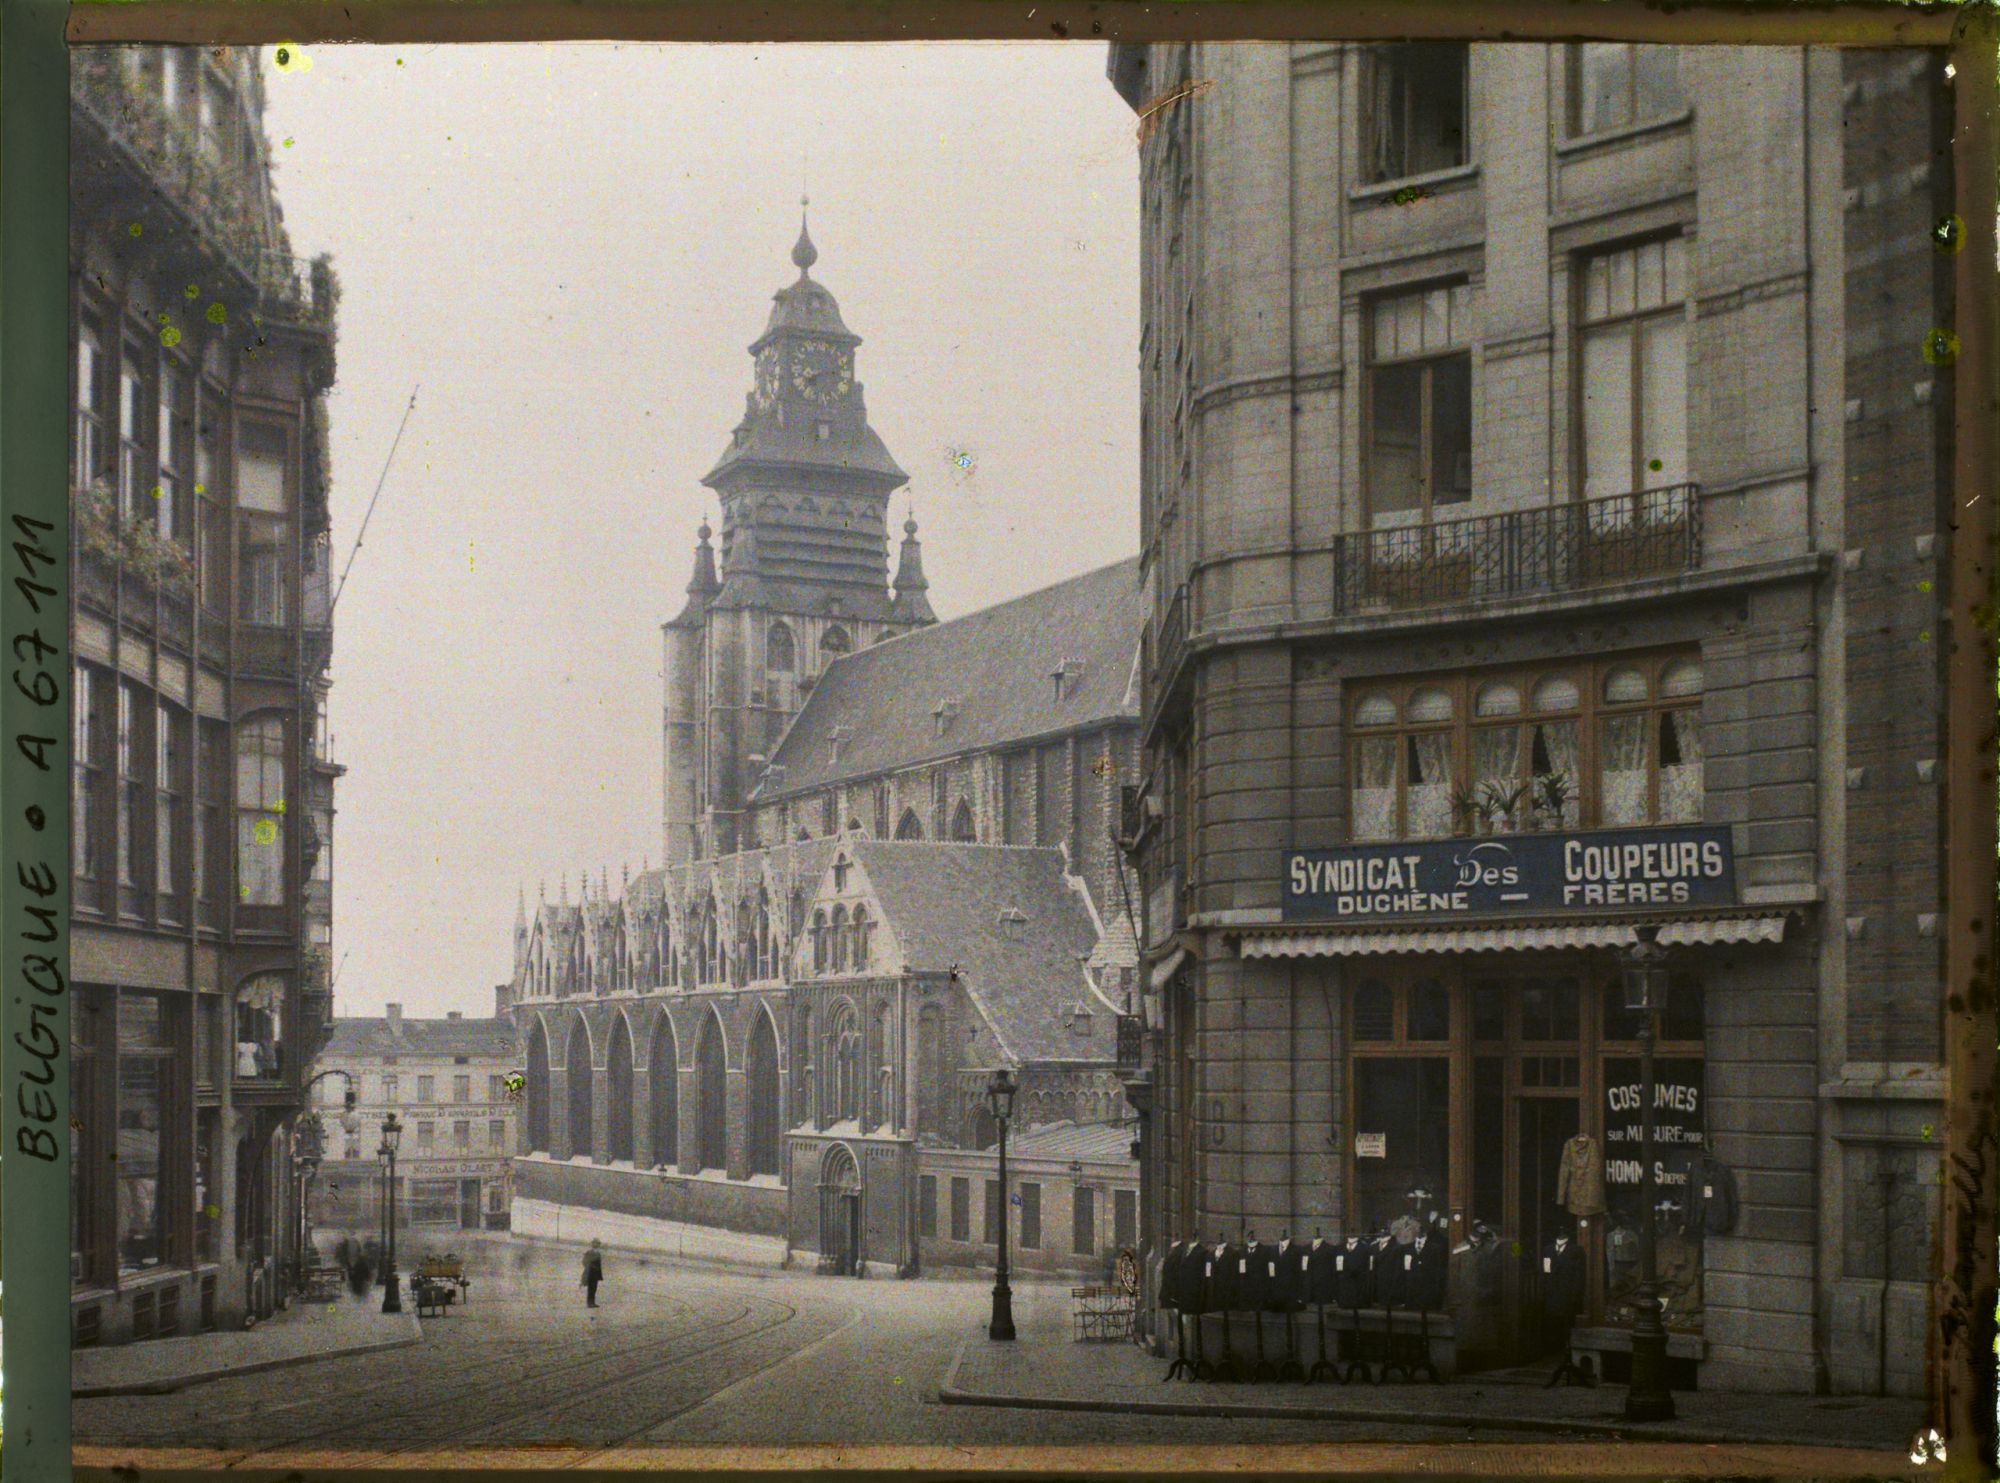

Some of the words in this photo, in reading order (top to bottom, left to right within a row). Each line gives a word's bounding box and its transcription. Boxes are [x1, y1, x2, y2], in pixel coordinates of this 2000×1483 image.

[16, 734, 57, 772] A
[1290, 854, 1421, 895] SYNDICAT
[1453, 842, 1519, 888] Des
[1563, 839, 1724, 883] COUPEURS
[1337, 889, 1469, 915] DUCHÊNE
[1608, 1083, 1698, 1112] COSUMES
[1607, 1130, 1625, 1141] SUR
[1684, 1132, 1704, 1144] POUR
[1606, 1160, 1664, 1184] HOMMS
